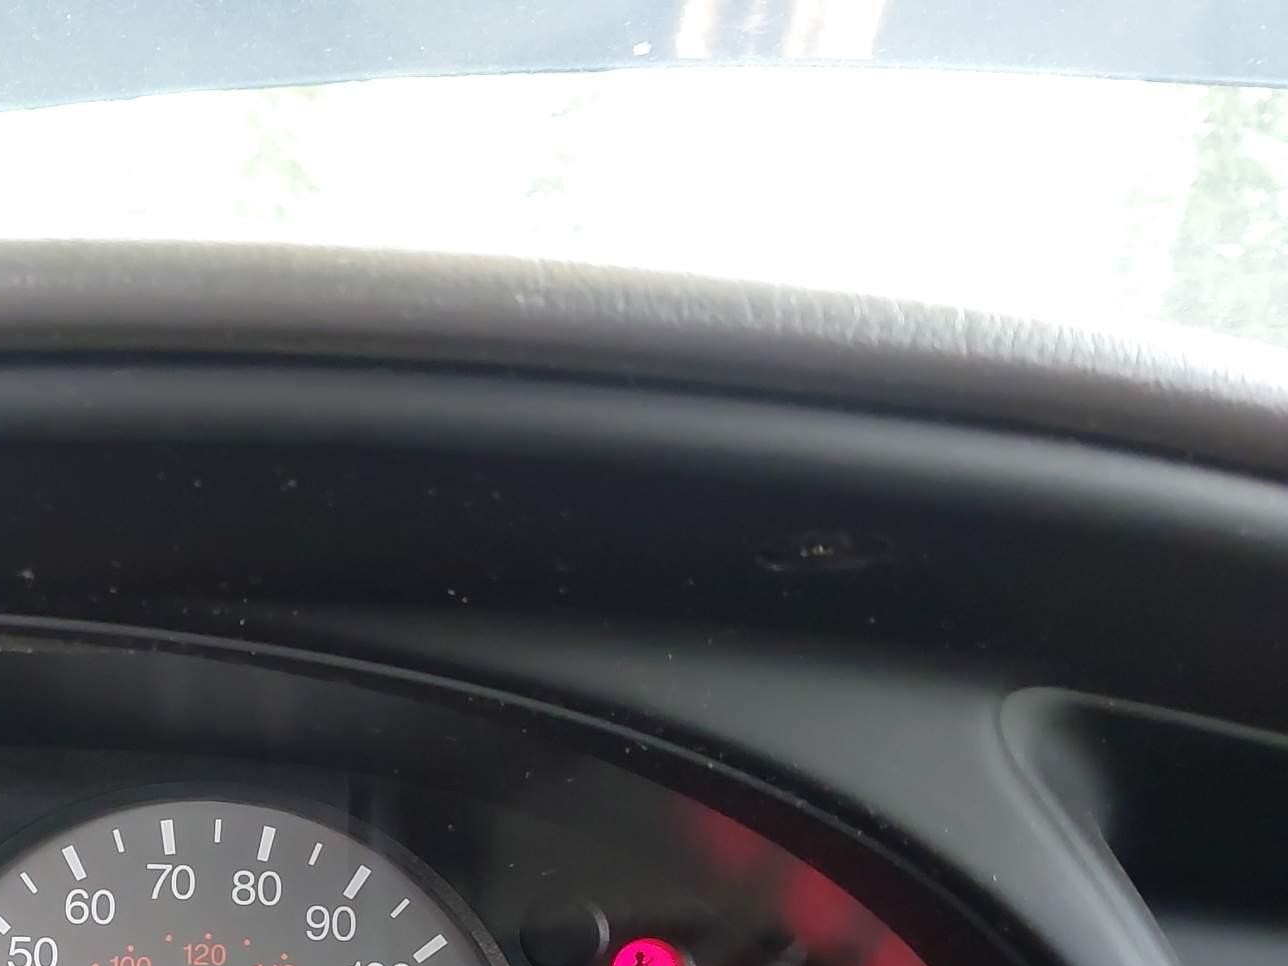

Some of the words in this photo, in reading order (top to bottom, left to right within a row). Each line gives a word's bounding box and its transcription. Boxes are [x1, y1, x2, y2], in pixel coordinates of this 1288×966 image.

[146, 864, 195, 900] 70
[232, 870, 282, 906] 80
[65, 890, 114, 925] 60
[305, 906, 356, 941] 90
[184, 943, 226, 966] 120
